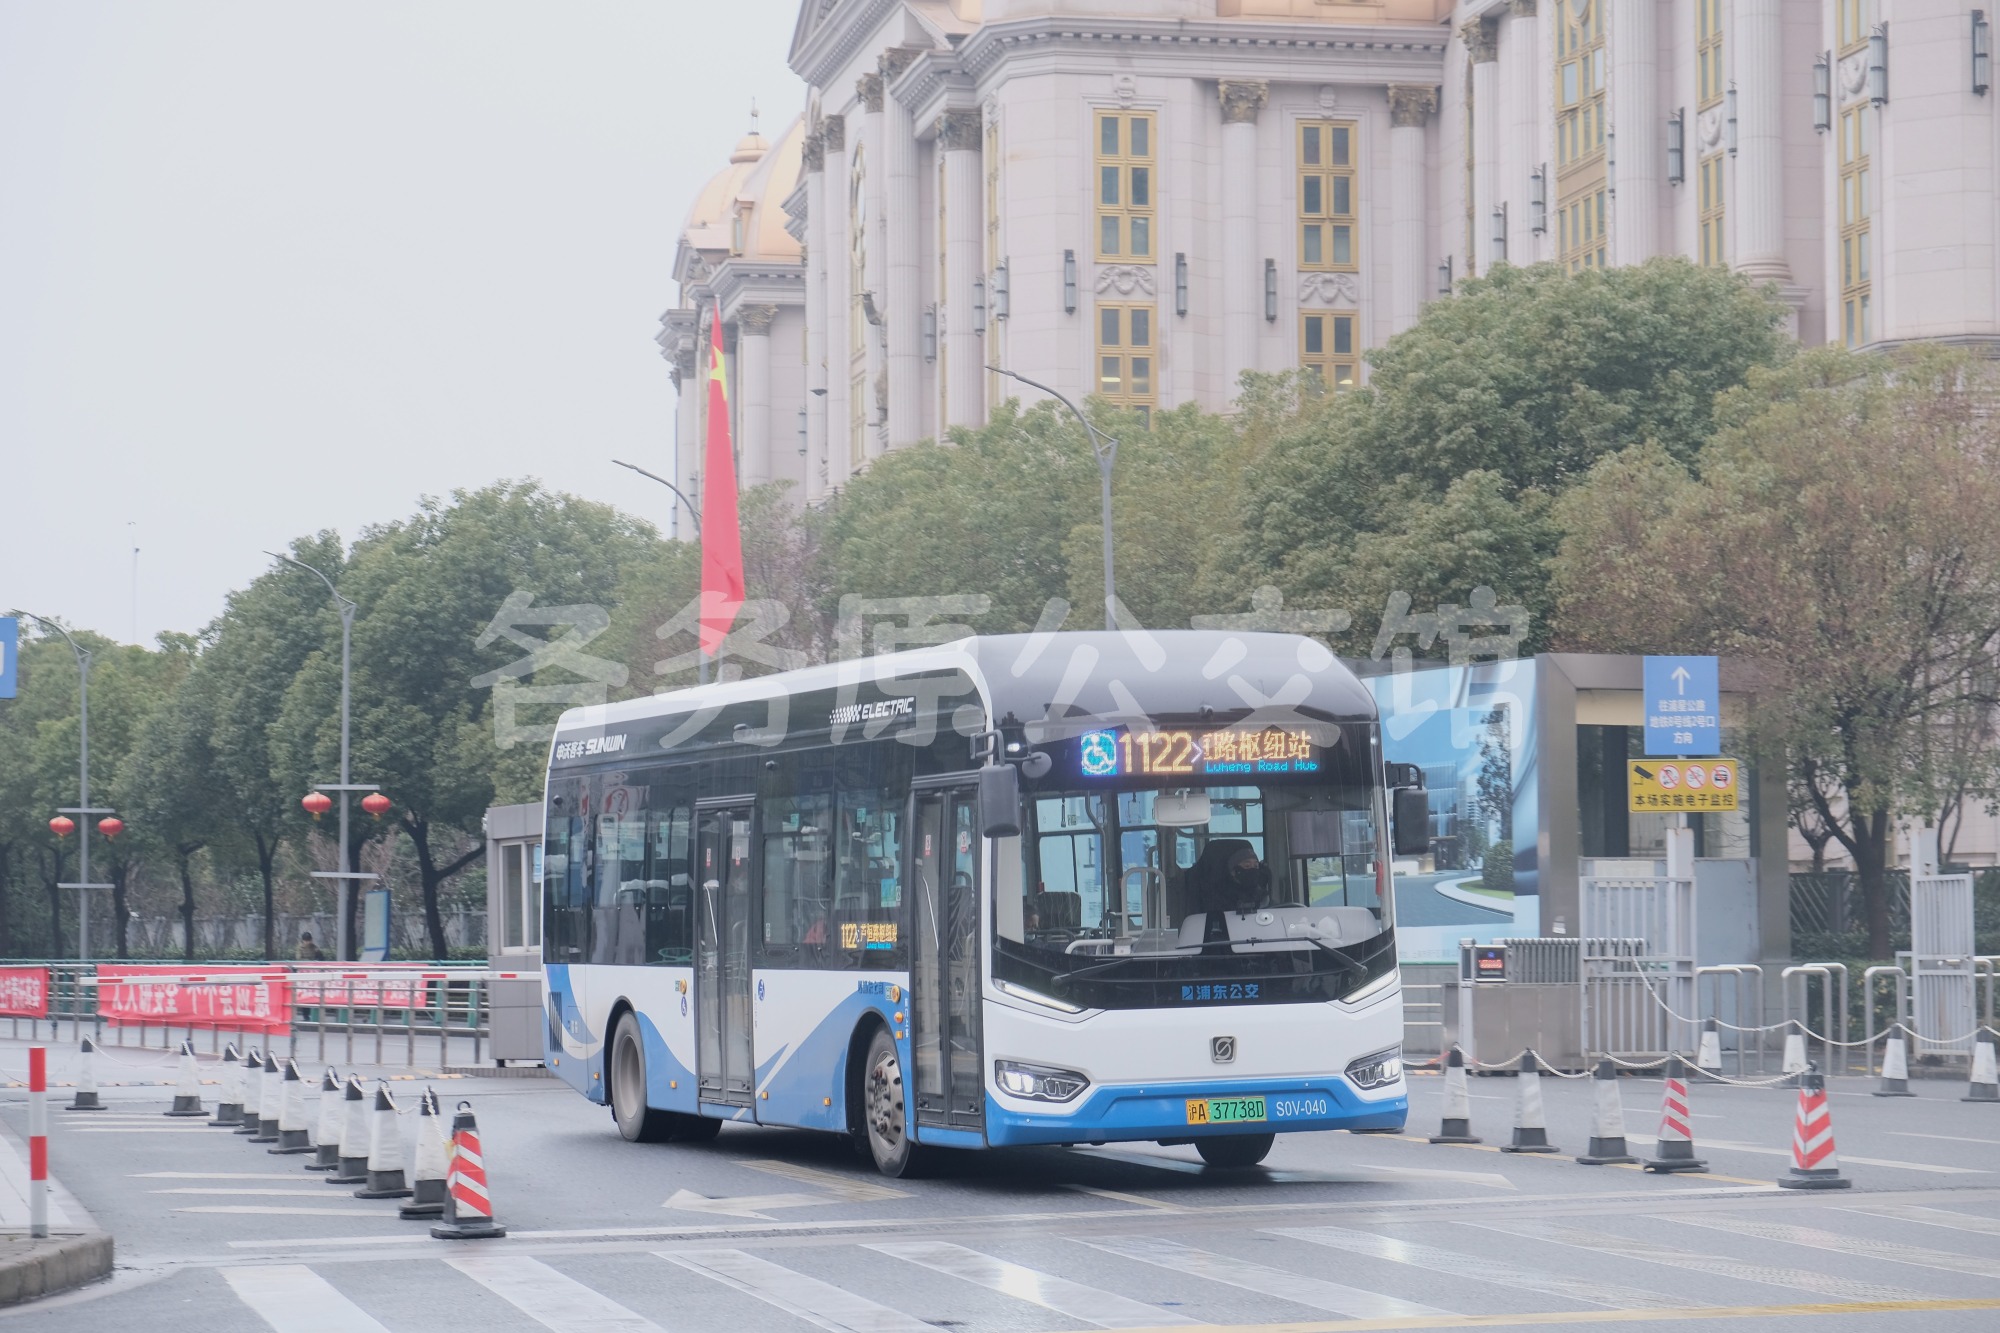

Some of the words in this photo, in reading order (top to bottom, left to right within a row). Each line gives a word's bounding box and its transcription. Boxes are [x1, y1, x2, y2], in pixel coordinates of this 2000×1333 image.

[862, 697, 915, 719] ELECTRIC
[1673, 732, 1692, 743] 方向
[556, 740, 585, 760] 申沃客车
[585, 733, 628, 755] SUNWIN
[1119, 731, 1194, 773] 1122
[1205, 761, 1251, 774] Luheng
[1258, 759, 1289, 772] Road
[1294, 758, 1317, 771] Hub
[1635, 794, 1734, 806] 本场实施电子监控
[1196, 984, 1259, 999] 浦东公交
